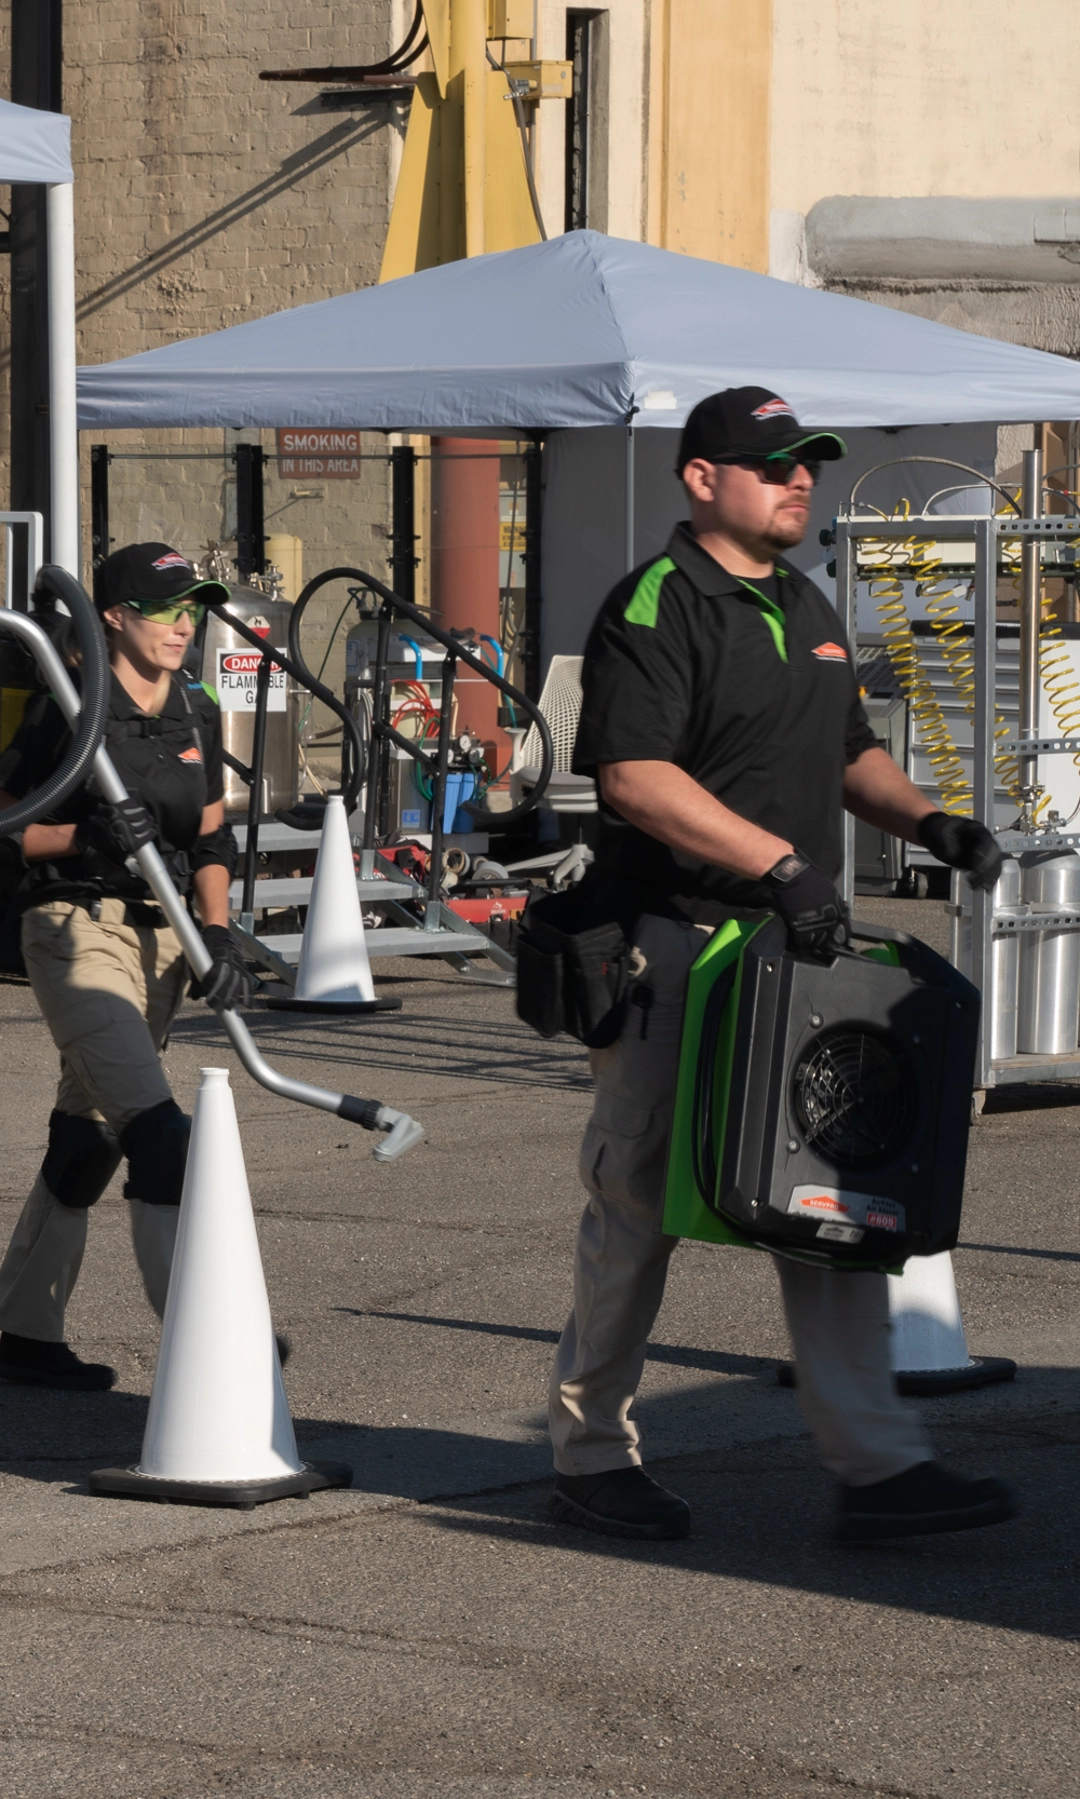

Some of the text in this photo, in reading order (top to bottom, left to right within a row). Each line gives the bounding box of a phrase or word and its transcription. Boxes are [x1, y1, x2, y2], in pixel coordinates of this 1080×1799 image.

[284, 434, 357, 451] SMOKING
[282, 458, 359, 472] IN THIS AREA
[809, 1199, 839, 1211] SERVPRO
